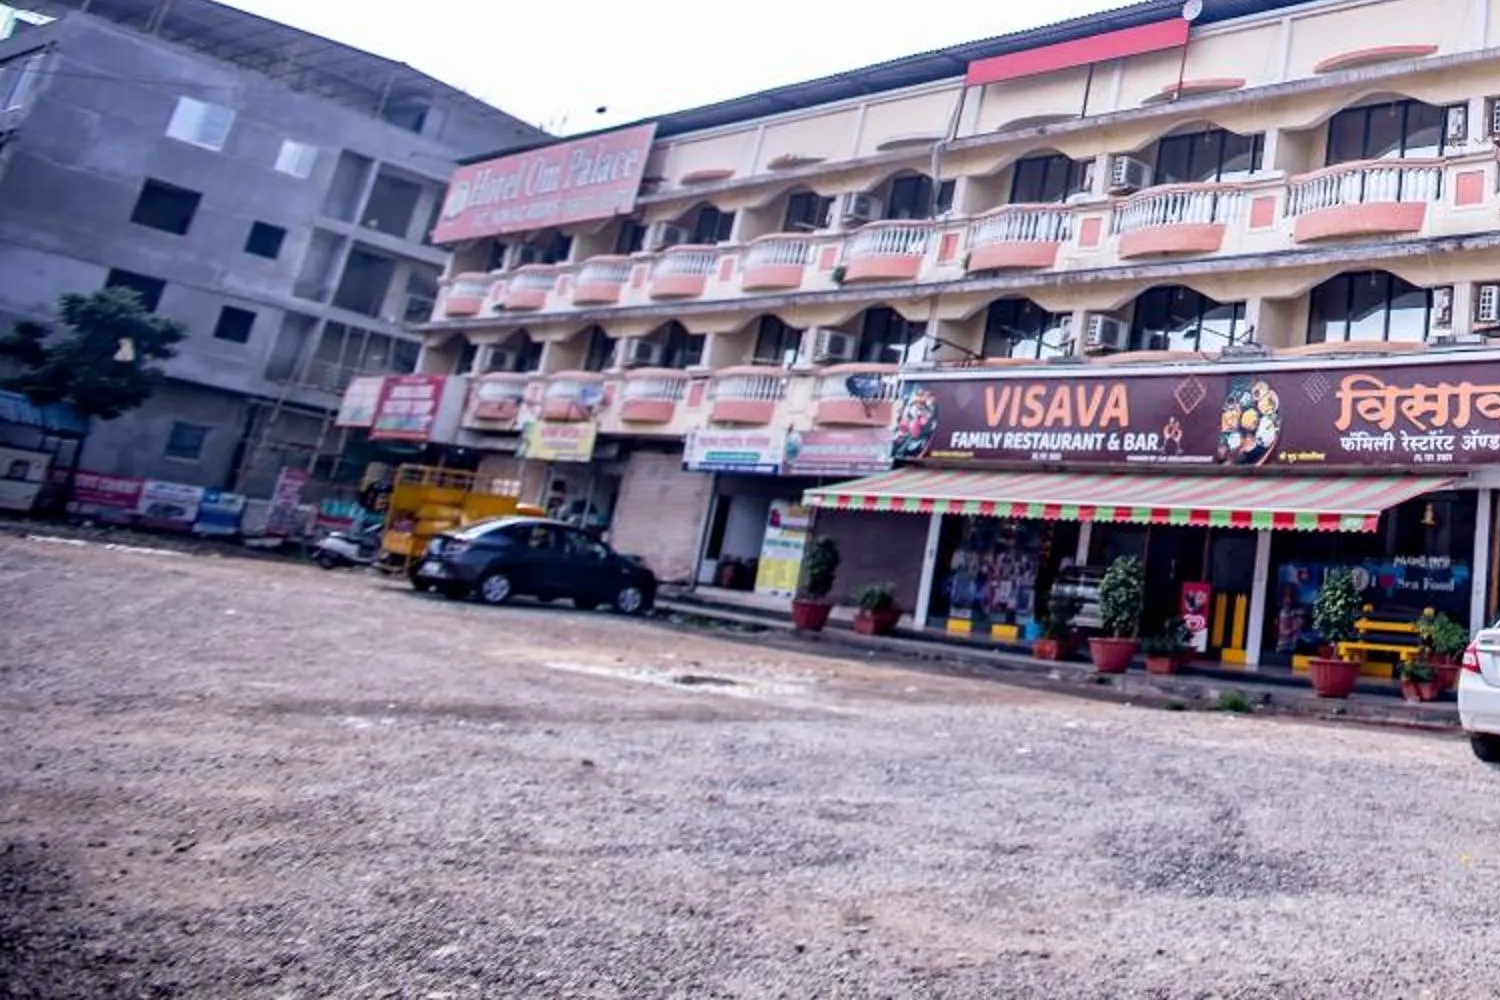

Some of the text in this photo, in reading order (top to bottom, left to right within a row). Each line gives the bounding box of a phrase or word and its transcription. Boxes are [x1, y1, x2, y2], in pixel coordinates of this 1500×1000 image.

[983, 382, 1130, 429] VISAVA
[950, 431, 1158, 451] FAMILY RESTAURANT & BAR
